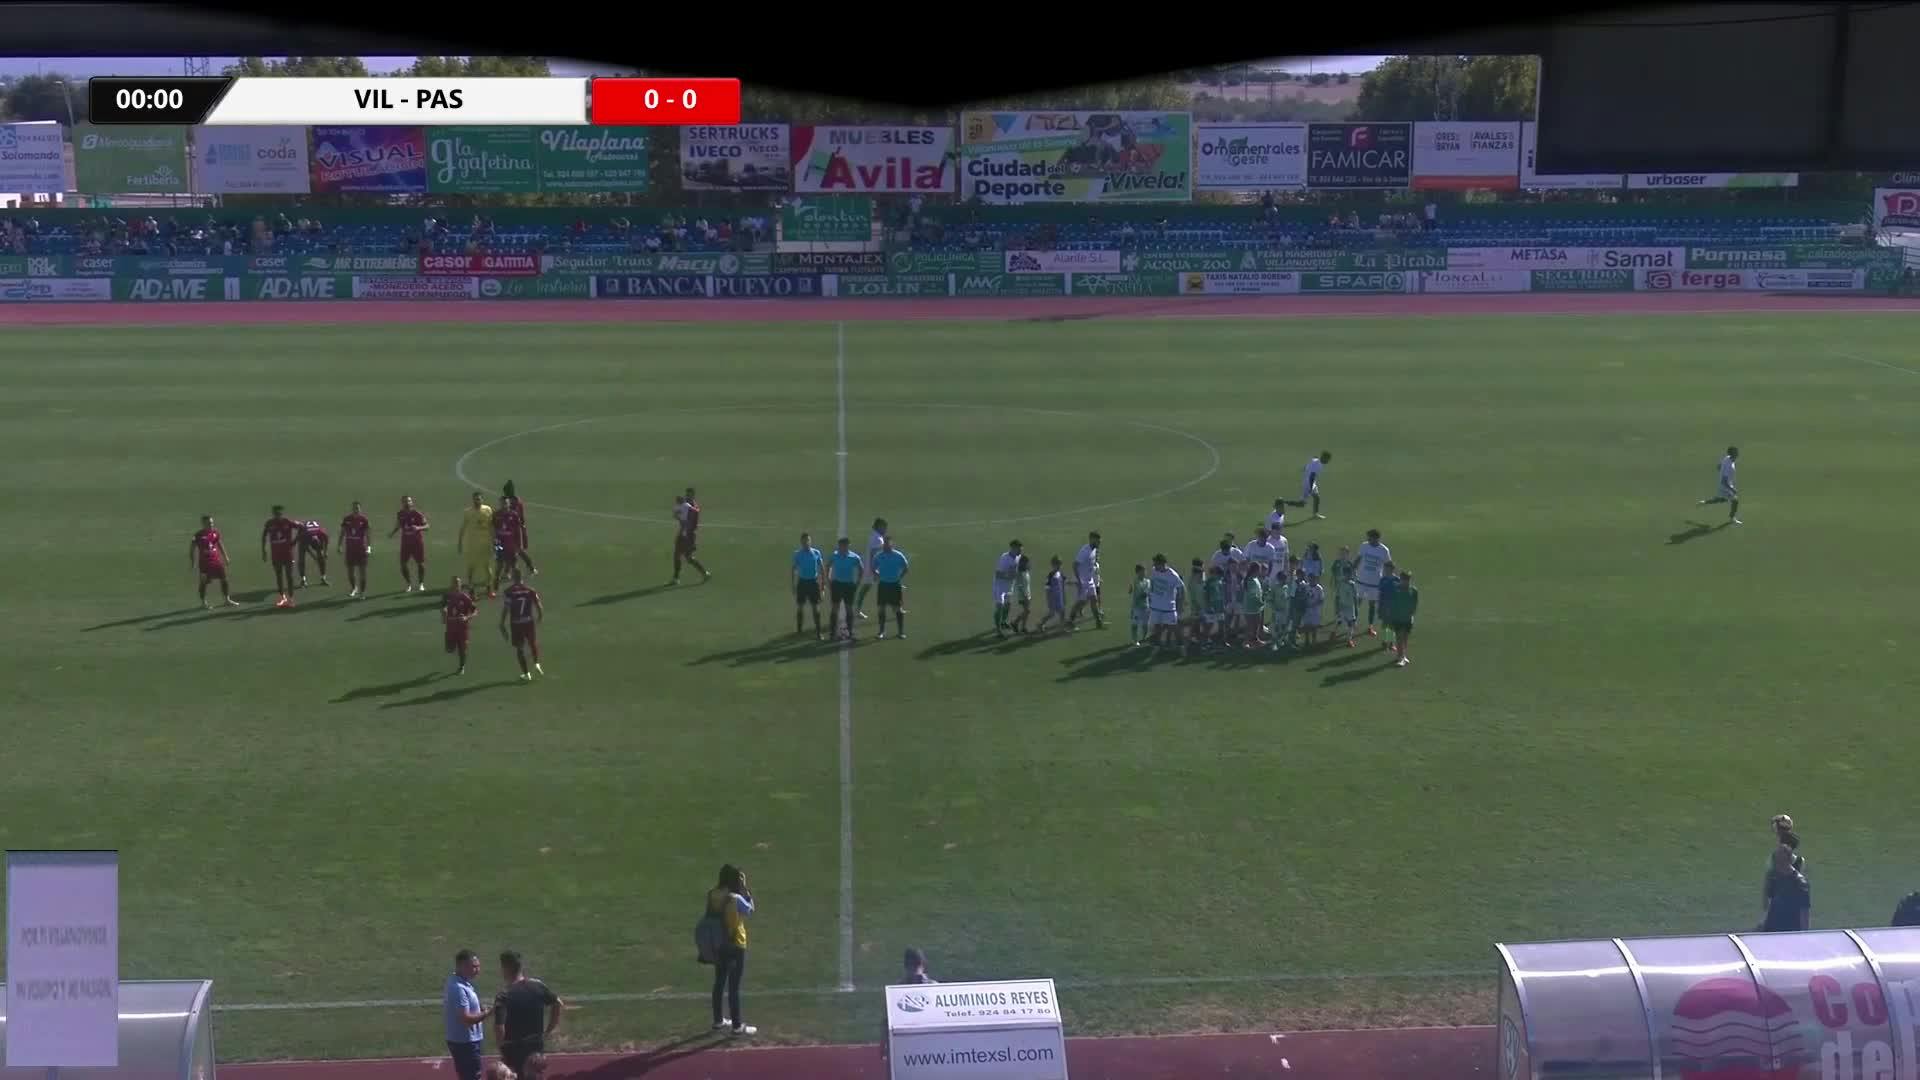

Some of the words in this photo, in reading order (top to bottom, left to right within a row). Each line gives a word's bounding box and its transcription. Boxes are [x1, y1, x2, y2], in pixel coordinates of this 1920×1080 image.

[689, 127, 779, 140] SERTRUCKS
[257, 145, 297, 160] coda
[541, 129, 645, 160] Vilaplana
[689, 145, 742, 158] IVECO
[319, 143, 423, 168] VISUAL
[1311, 151, 1406, 168] FAMICAR
[967, 158, 1046, 177] Ciudad
[1646, 173, 1706, 185] urbaser
[975, 180, 1065, 199] Deporte
[83, 258, 114, 268] caser
[800, 254, 883, 264] MONTAJEX
[1511, 249, 1567, 261] METASA
[1605, 250, 1673, 267] Samat
[1202, 260, 1231, 270] ZOO
[627, 277, 705, 295] BANCA
[715, 277, 792, 295] PUEYO
[1320, 275, 1383, 287] SPAR
[1682, 272, 1741, 288] ferga
[935, 992, 1006, 1008] ALUMINIOS
[1011, 991, 1049, 1005] REYES
[904, 1047, 1054, 1066] www.imtexsl.com
